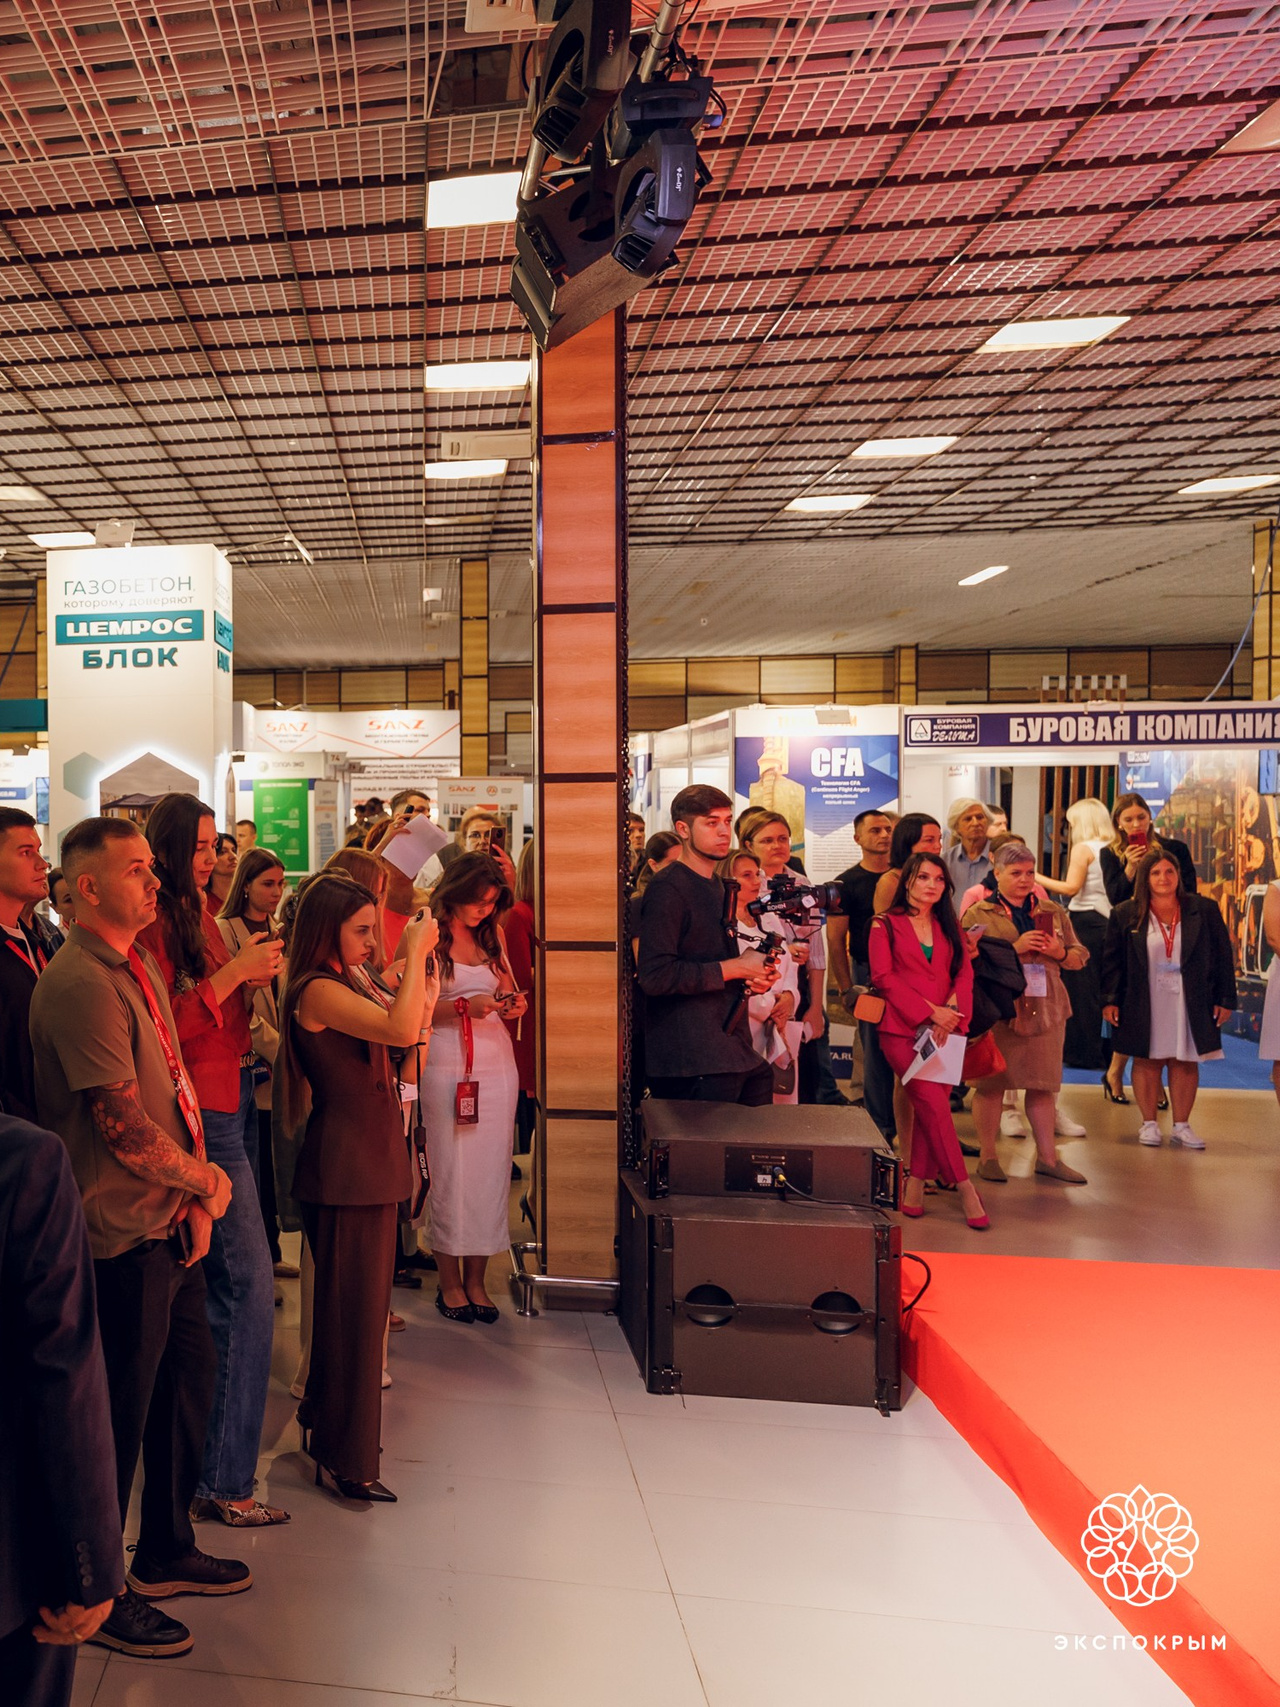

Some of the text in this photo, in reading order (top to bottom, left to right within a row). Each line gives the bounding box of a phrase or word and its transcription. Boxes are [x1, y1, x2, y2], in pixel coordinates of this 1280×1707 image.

[64, 596, 194, 610] которому доверяют
[66, 617, 193, 637] ЦЕМРОС
[82, 647, 178, 669] БЛОК
[266, 722, 308, 732] SANZ
[368, 719, 425, 730] SANZ
[1009, 715, 1131, 742] БУРОВАЯ
[811, 747, 865, 777] CFA
